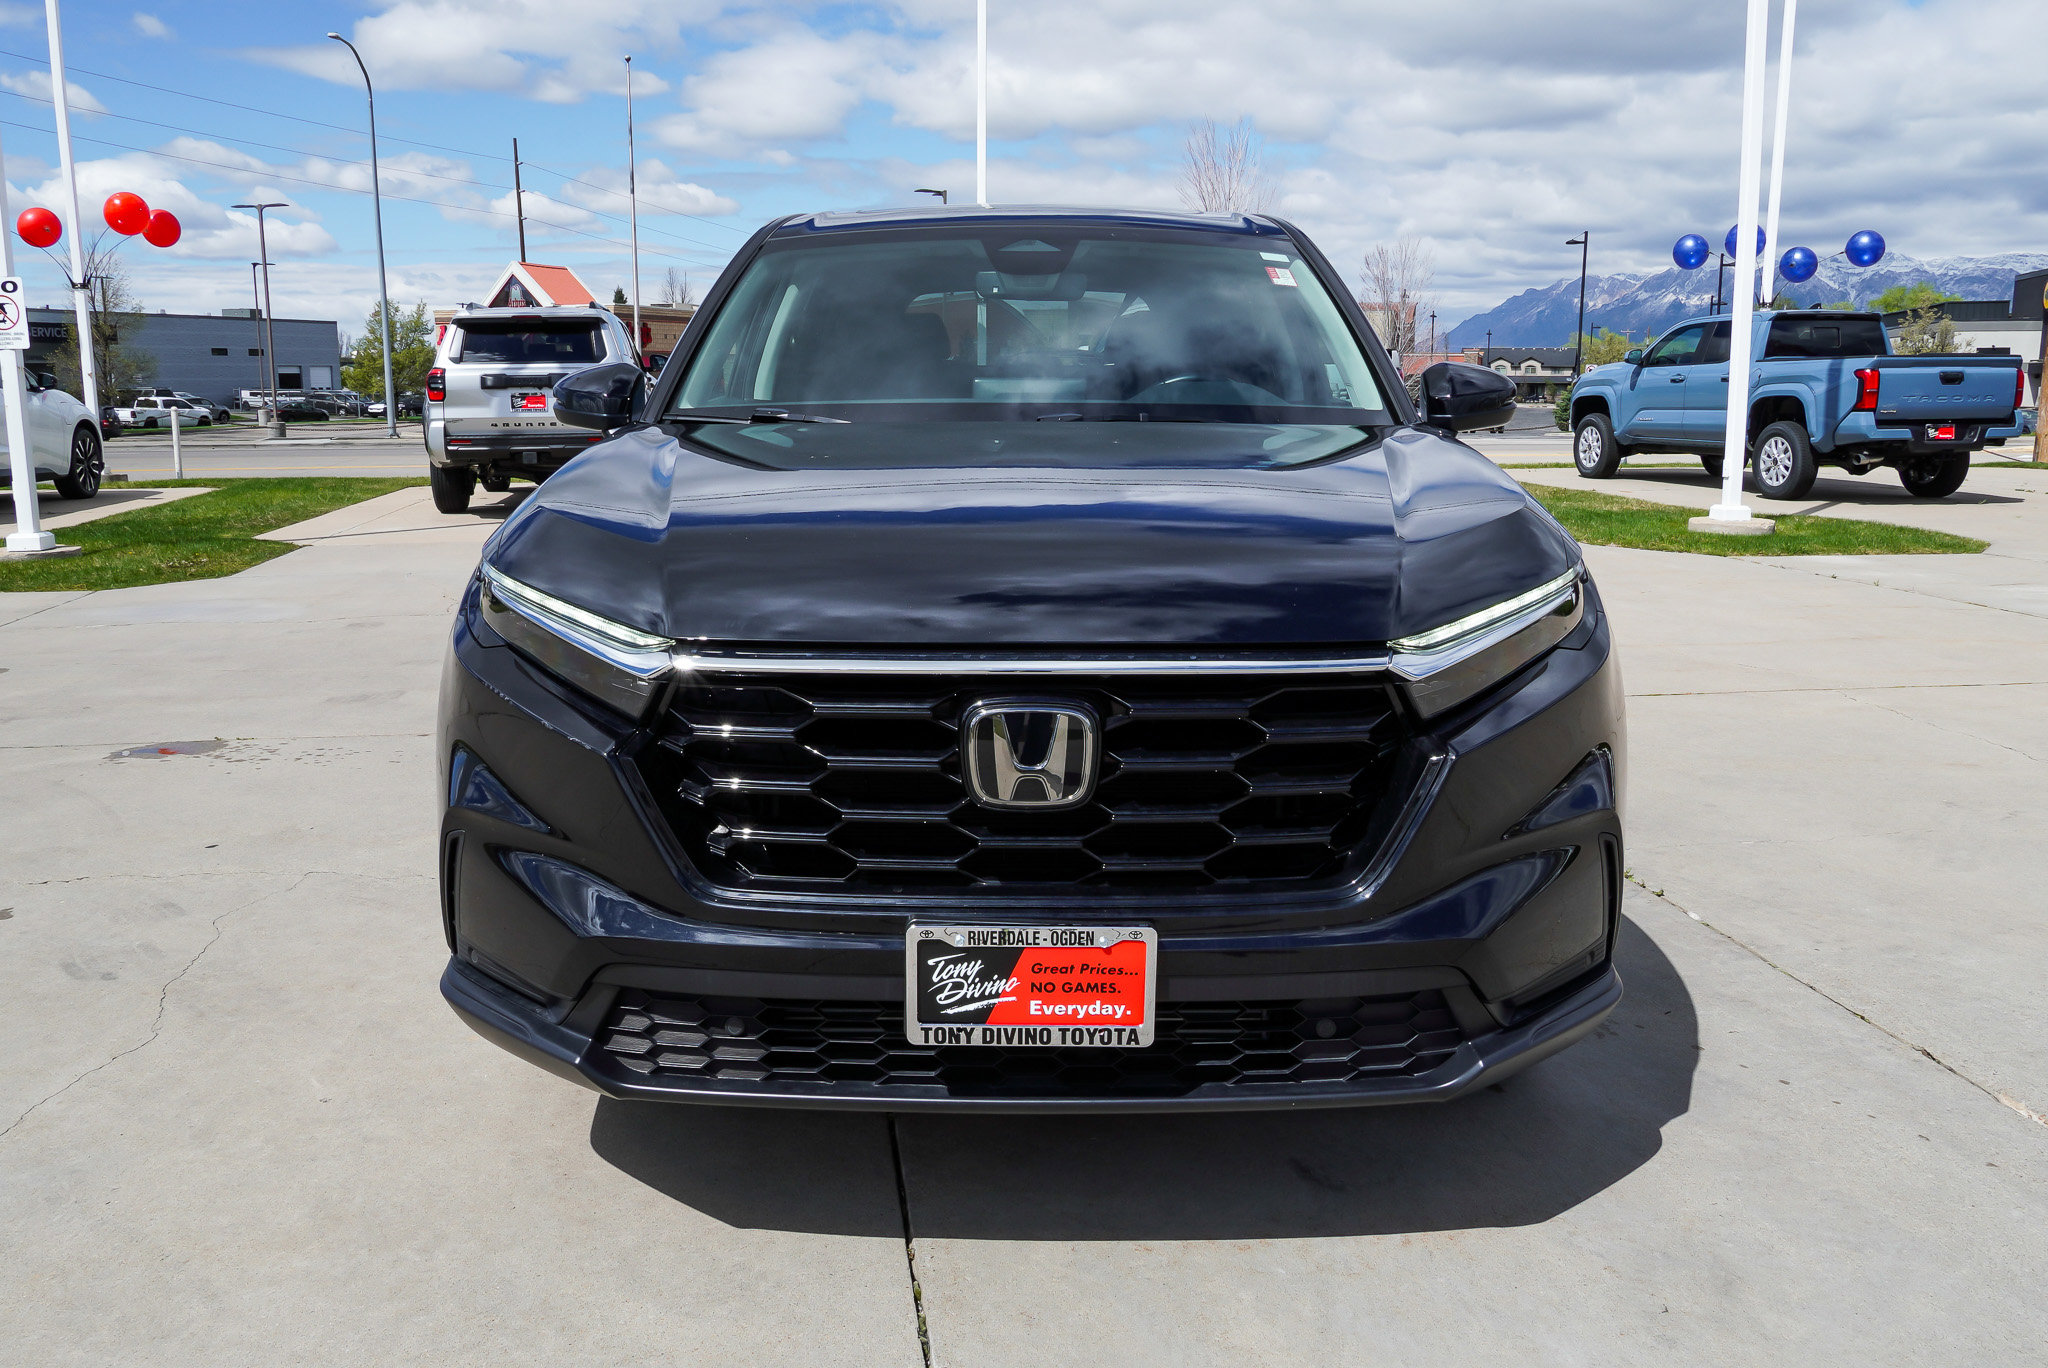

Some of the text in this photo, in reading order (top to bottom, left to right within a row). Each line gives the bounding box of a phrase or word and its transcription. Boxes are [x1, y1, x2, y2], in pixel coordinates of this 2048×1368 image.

[0, 281, 18, 293] O
[29, 327, 68, 338] ERVICE
[1902, 394, 1996, 403] TACOMA
[968, 931, 1040, 946] RIVERDALE
[1050, 931, 1095, 946] OGDEN
[927, 953, 984, 984] Tony
[1031, 963, 1139, 976] Great Prices...
[927, 974, 1021, 1005] Divino
[1030, 982, 1122, 994] NO GAMES.
[1029, 1000, 1132, 1019] Everyday.
[920, 1026, 1140, 1046] TONY DIVINO TOYOTA
